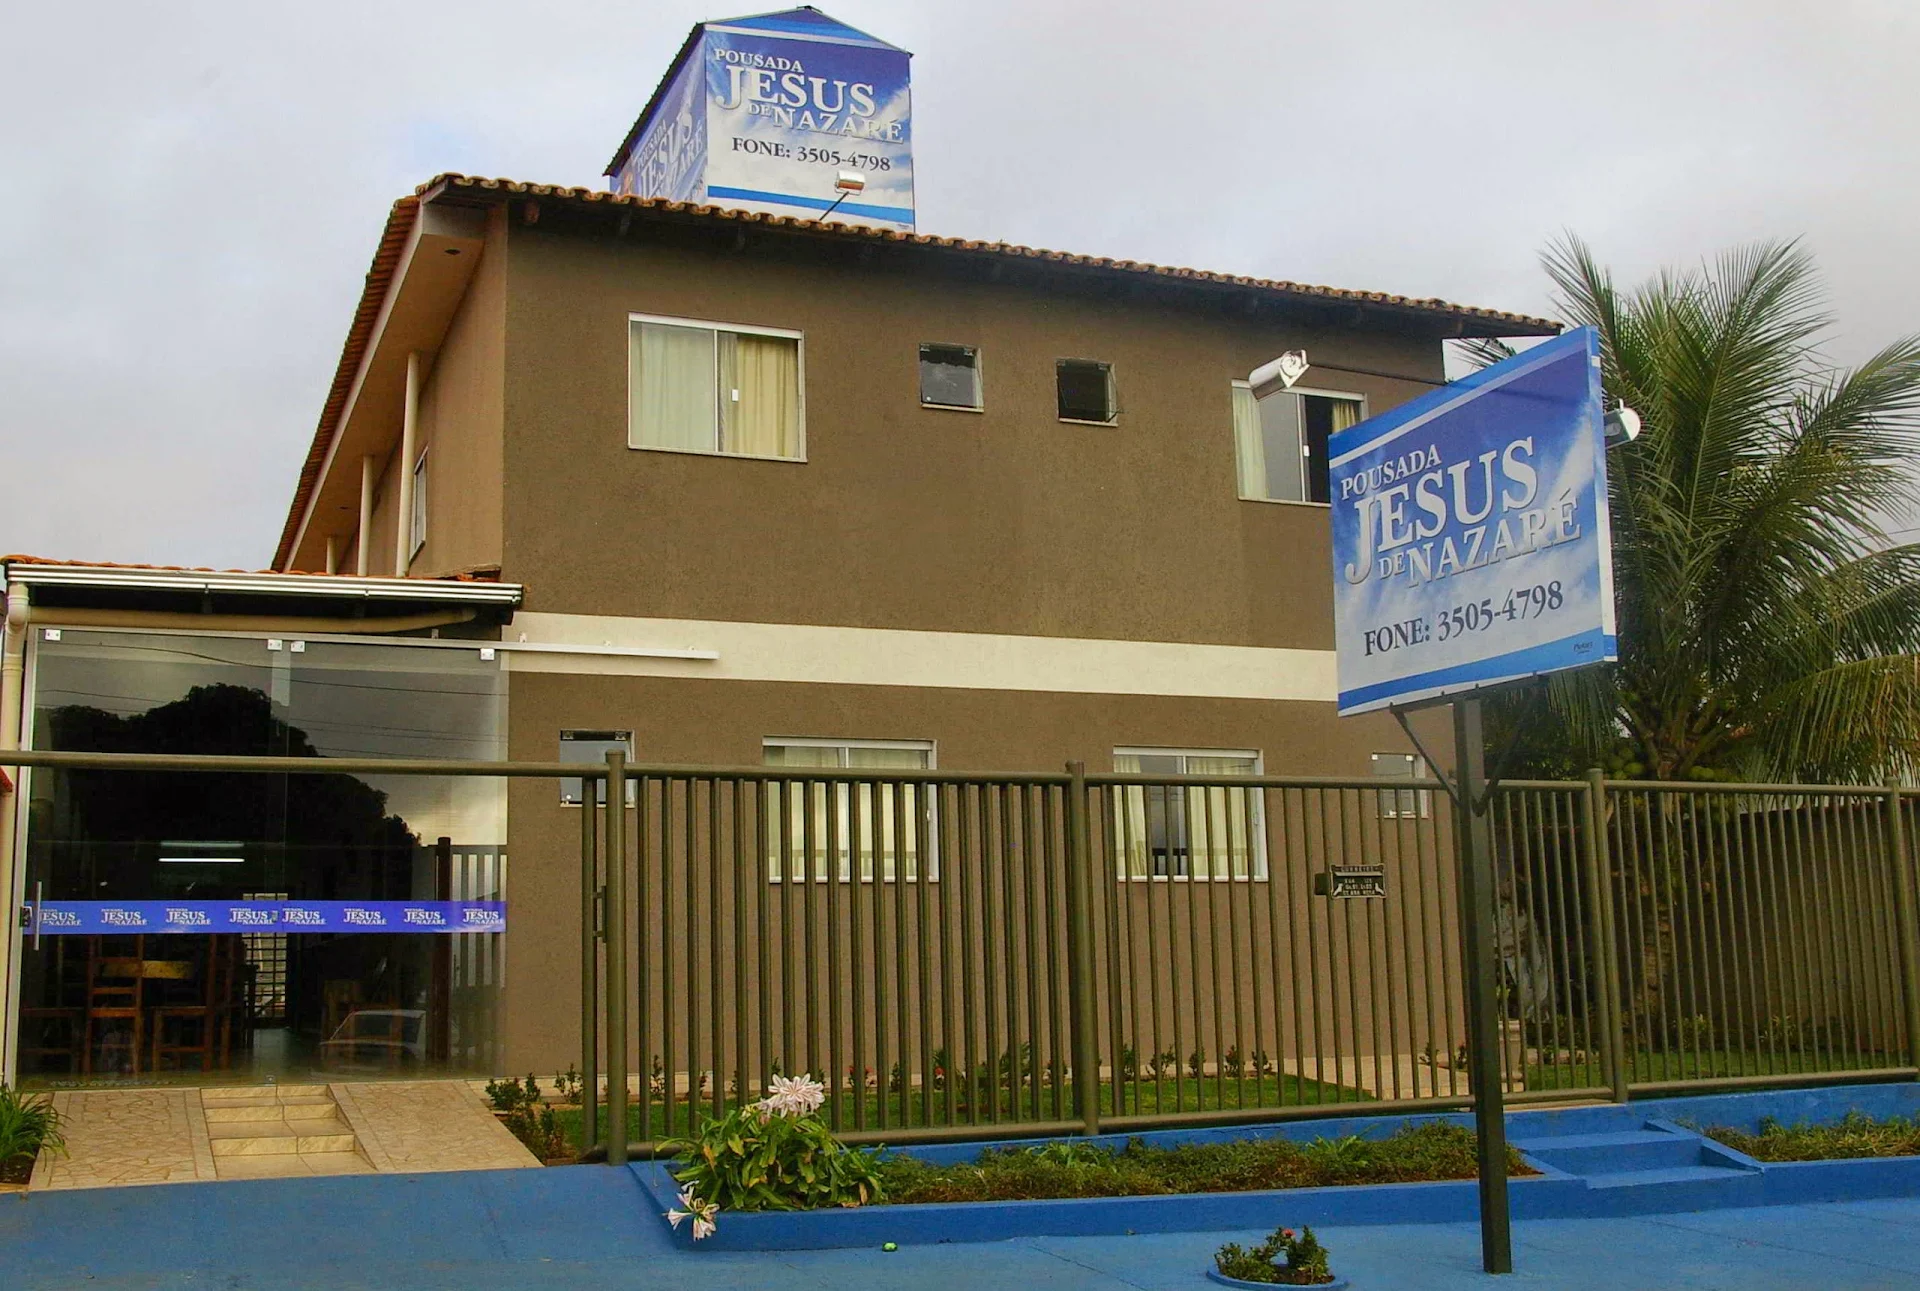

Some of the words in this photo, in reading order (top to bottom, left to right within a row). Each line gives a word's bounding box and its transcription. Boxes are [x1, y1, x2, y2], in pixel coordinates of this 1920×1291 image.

[714, 48, 804, 74] POUSADA
[715, 64, 877, 118] JESUS
[748, 103, 772, 118] DE
[772, 107, 904, 144] NAZARÉ
[732, 137, 791, 159] FONE:
[797, 145, 891, 172] 3505-4798
[1340, 443, 1442, 500] POUSADA
[1345, 436, 1538, 585] JESUS
[1378, 553, 1406, 580] DE
[1406, 488, 1581, 589] NAZARÉ
[1364, 617, 1431, 656] FONE:
[1438, 580, 1563, 642] 3505-4798
[100, 911, 141, 923] JESUS
[165, 911, 205, 923] JESUS
[229, 911, 268, 923] JESUS
[282, 911, 320, 923] JESUS
[343, 911, 381, 923] JESUS
[403, 911, 440, 923] JESUS
[462, 911, 499, 923] JESUS
